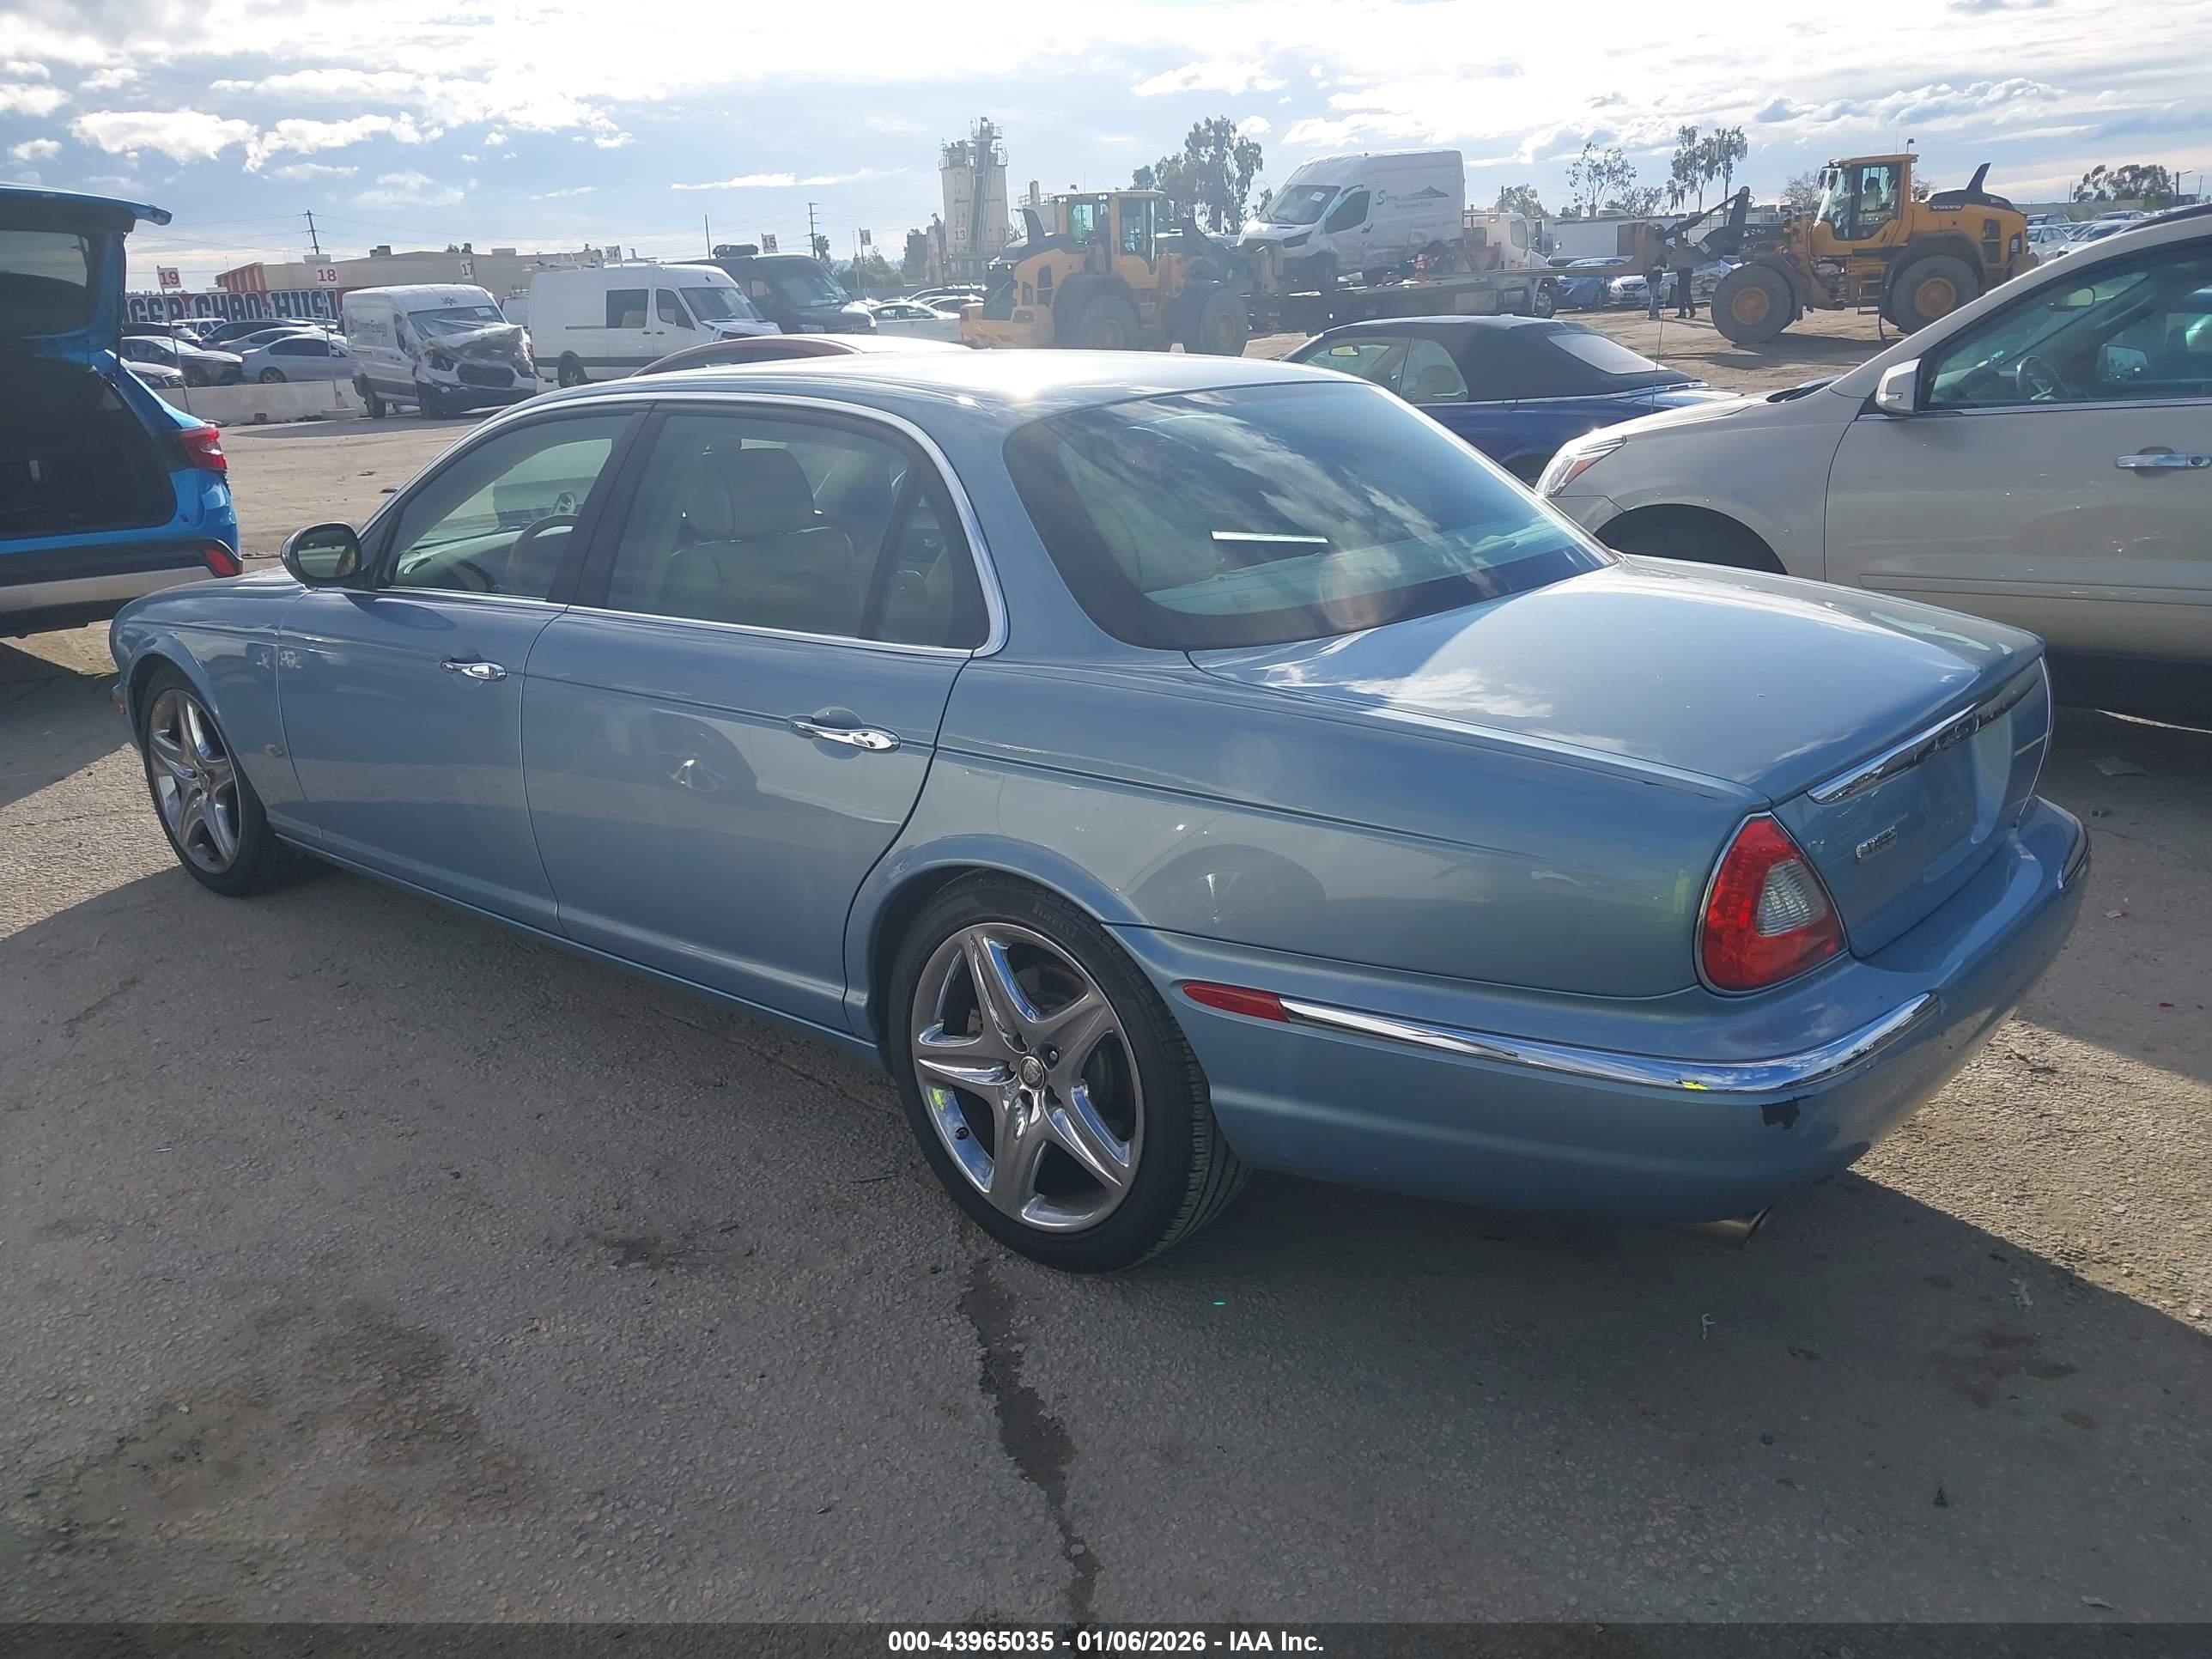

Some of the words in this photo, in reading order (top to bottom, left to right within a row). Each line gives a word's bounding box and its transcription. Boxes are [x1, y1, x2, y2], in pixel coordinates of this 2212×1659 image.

[860, 233, 871, 243] 14
[955, 230, 965, 240] 13
[763, 237, 776, 249] 15
[461, 263, 473, 276] 17
[160, 271, 179, 285] 19
[317, 269, 337, 283] 18
